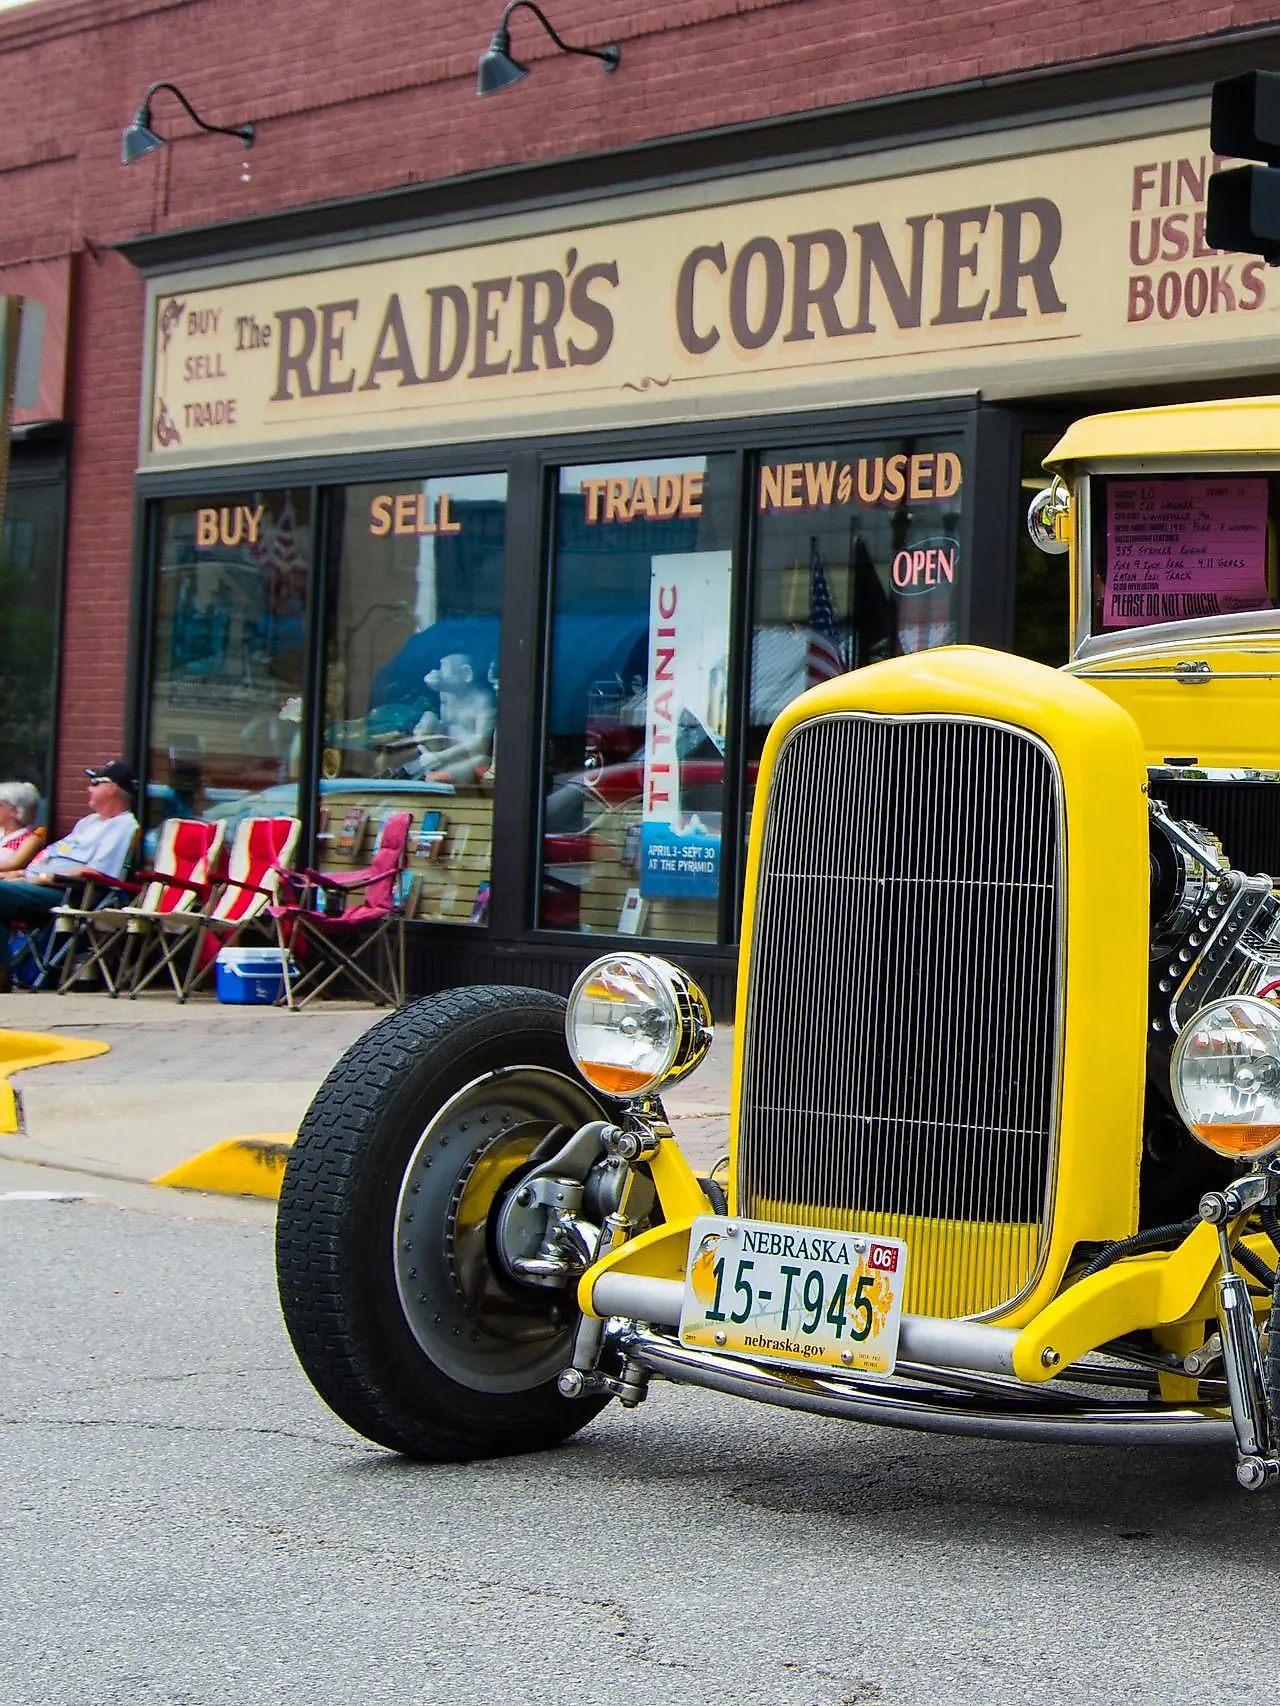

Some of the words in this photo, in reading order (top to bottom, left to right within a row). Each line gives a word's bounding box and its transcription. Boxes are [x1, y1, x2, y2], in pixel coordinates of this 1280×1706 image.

[1129, 211, 1238, 267] USE
[235, 314, 271, 351] The
[269, 247, 620, 401] READER'S
[675, 196, 1067, 356] CORNER
[1127, 260, 1267, 323] BOOKS
[187, 308, 222, 337] BUY
[183, 352, 227, 382] SELL
[184, 399, 237, 429] TRADE
[580, 470, 704, 526] TRADE
[758, 460, 837, 515] NEW
[856, 451, 963, 505] USED
[196, 505, 265, 547] BUY
[370, 493, 462, 537] SELL
[892, 547, 956, 588] OPEN
[1111, 594, 1145, 617] PLEASE
[1146, 594, 1160, 617] DO
[1161, 593, 1180, 617] NOT
[649, 585, 677, 812] TITANIC
[648, 845, 671, 857] APRIL
[648, 858, 658, 869] AT
[660, 859, 676, 871] THE
[677, 861, 714, 873] PYRAMID
[742, 1230, 851, 1265] NEBRASKA
[872, 1248, 892, 1268] 06
[705, 1256, 875, 1342] 15-T945
[744, 1334, 826, 1359] nebraska.gov
